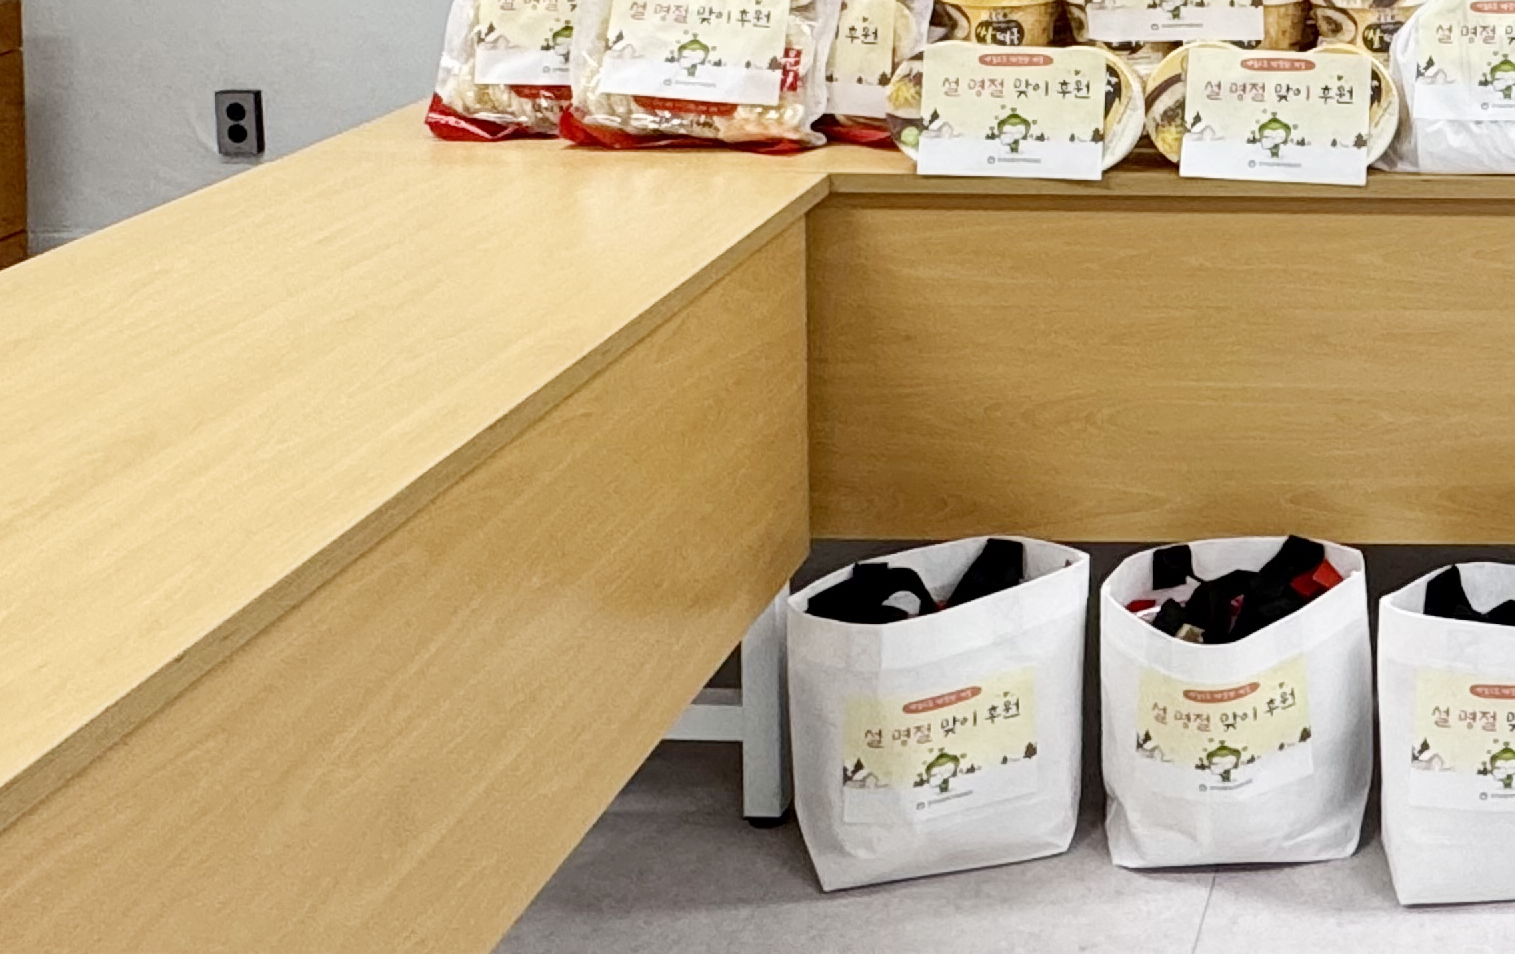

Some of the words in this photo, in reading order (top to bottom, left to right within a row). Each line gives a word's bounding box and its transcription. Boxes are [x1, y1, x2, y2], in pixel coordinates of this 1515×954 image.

[629, 0, 647, 21] 설
[654, 3, 689, 25] 명절
[697, 6, 731, 26] 맞이
[736, 9, 771, 28] 후원
[1436, 25, 1453, 44] 설
[1461, 25, 1497, 45] 명절
[942, 78, 960, 97] 설
[967, 78, 1005, 98] 명절
[1013, 79, 1050, 99] 맞이
[1056, 79, 1091, 99] 후원
[1204, 80, 1222, 101] 설
[1229, 82, 1266, 102] 명절
[1274, 83, 1311, 103] 맞이
[1318, 84, 1354, 104] 후원
[864, 728, 885, 749] 설
[892, 723, 933, 747] 명절
[941, 710, 978, 737] 맞이
[985, 697, 1021, 725] 후원
[1152, 701, 1168, 726] 설
[1174, 711, 1211, 732] 명절
[1220, 706, 1258, 732] 맞이
[1264, 688, 1296, 716] 후원
[1431, 705, 1451, 728] 설
[1458, 710, 1498, 732] 명절
